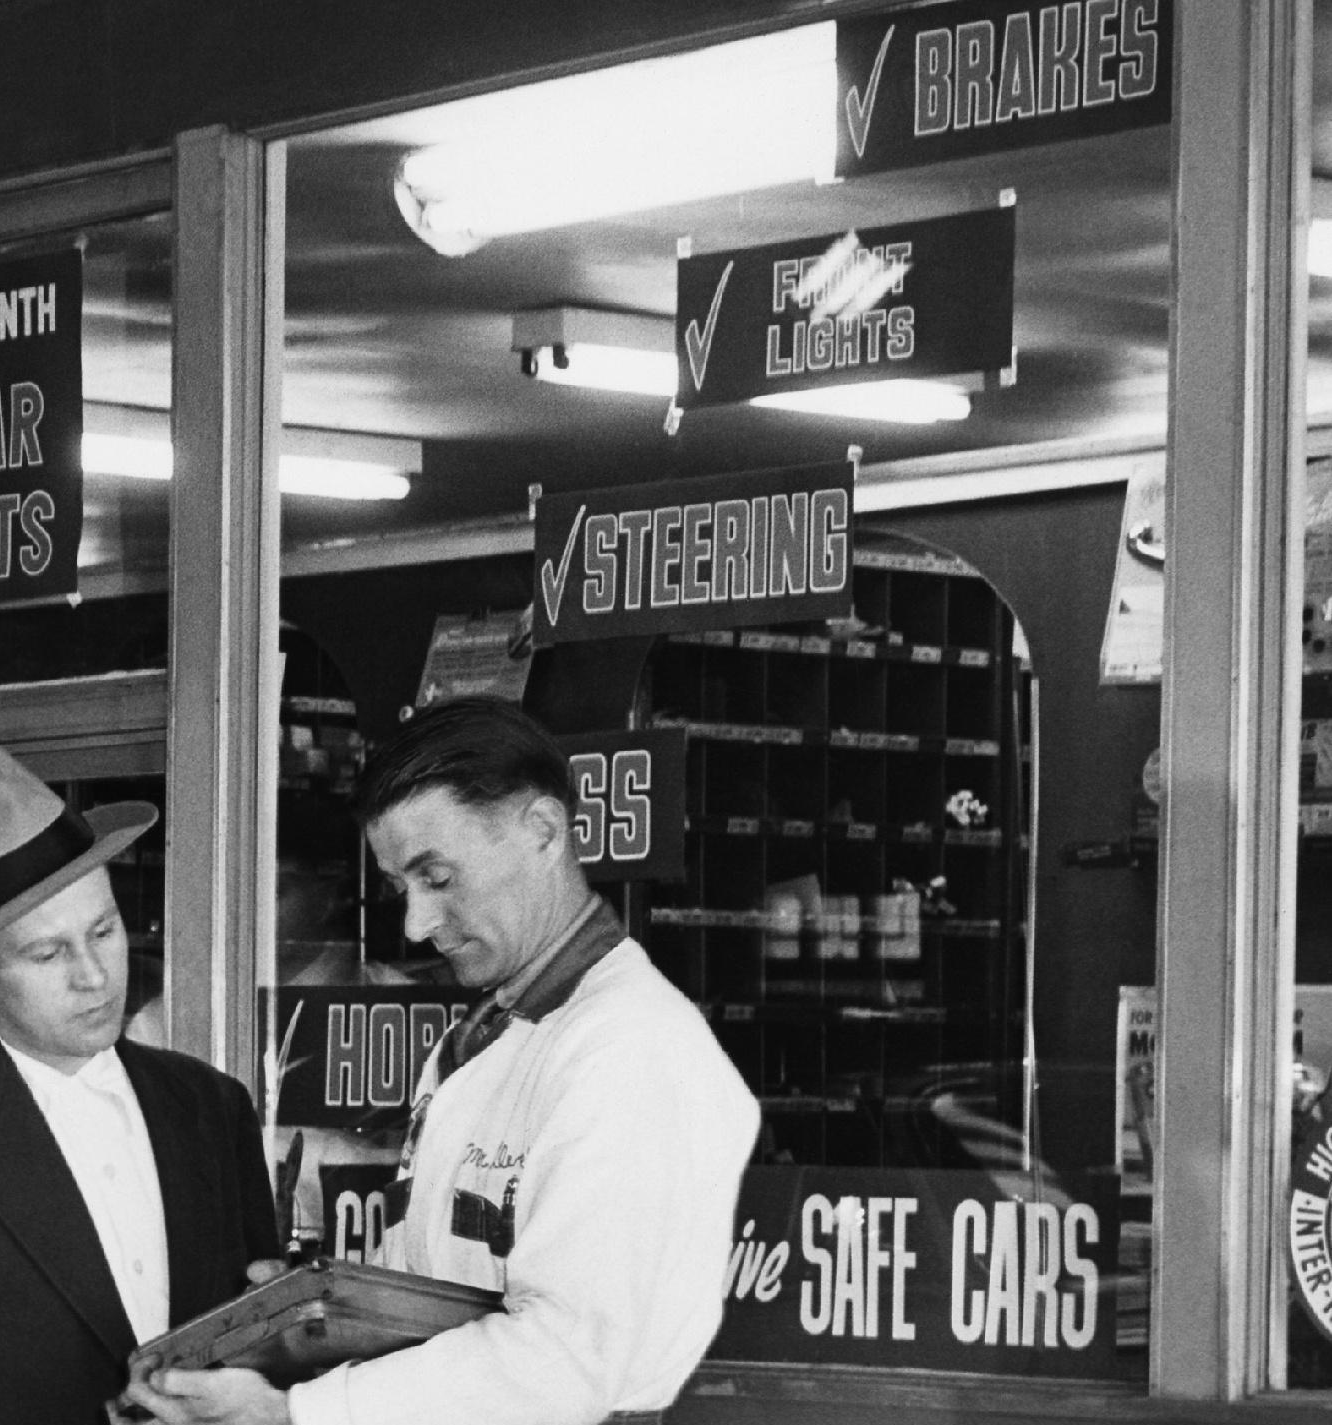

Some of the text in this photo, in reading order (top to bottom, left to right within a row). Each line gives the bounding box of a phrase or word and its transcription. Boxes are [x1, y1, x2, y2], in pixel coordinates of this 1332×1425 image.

[913, 0, 1159, 137] BRAKES
[772, 241, 913, 315] FRNT
[765, 305, 916, 377] LIGHTS
[582, 487, 849, 615] STEERING
[325, 1003, 469, 1107] HOR
[799, 1193, 918, 1341] SAFE
[950, 1200, 1100, 1350] CARS
